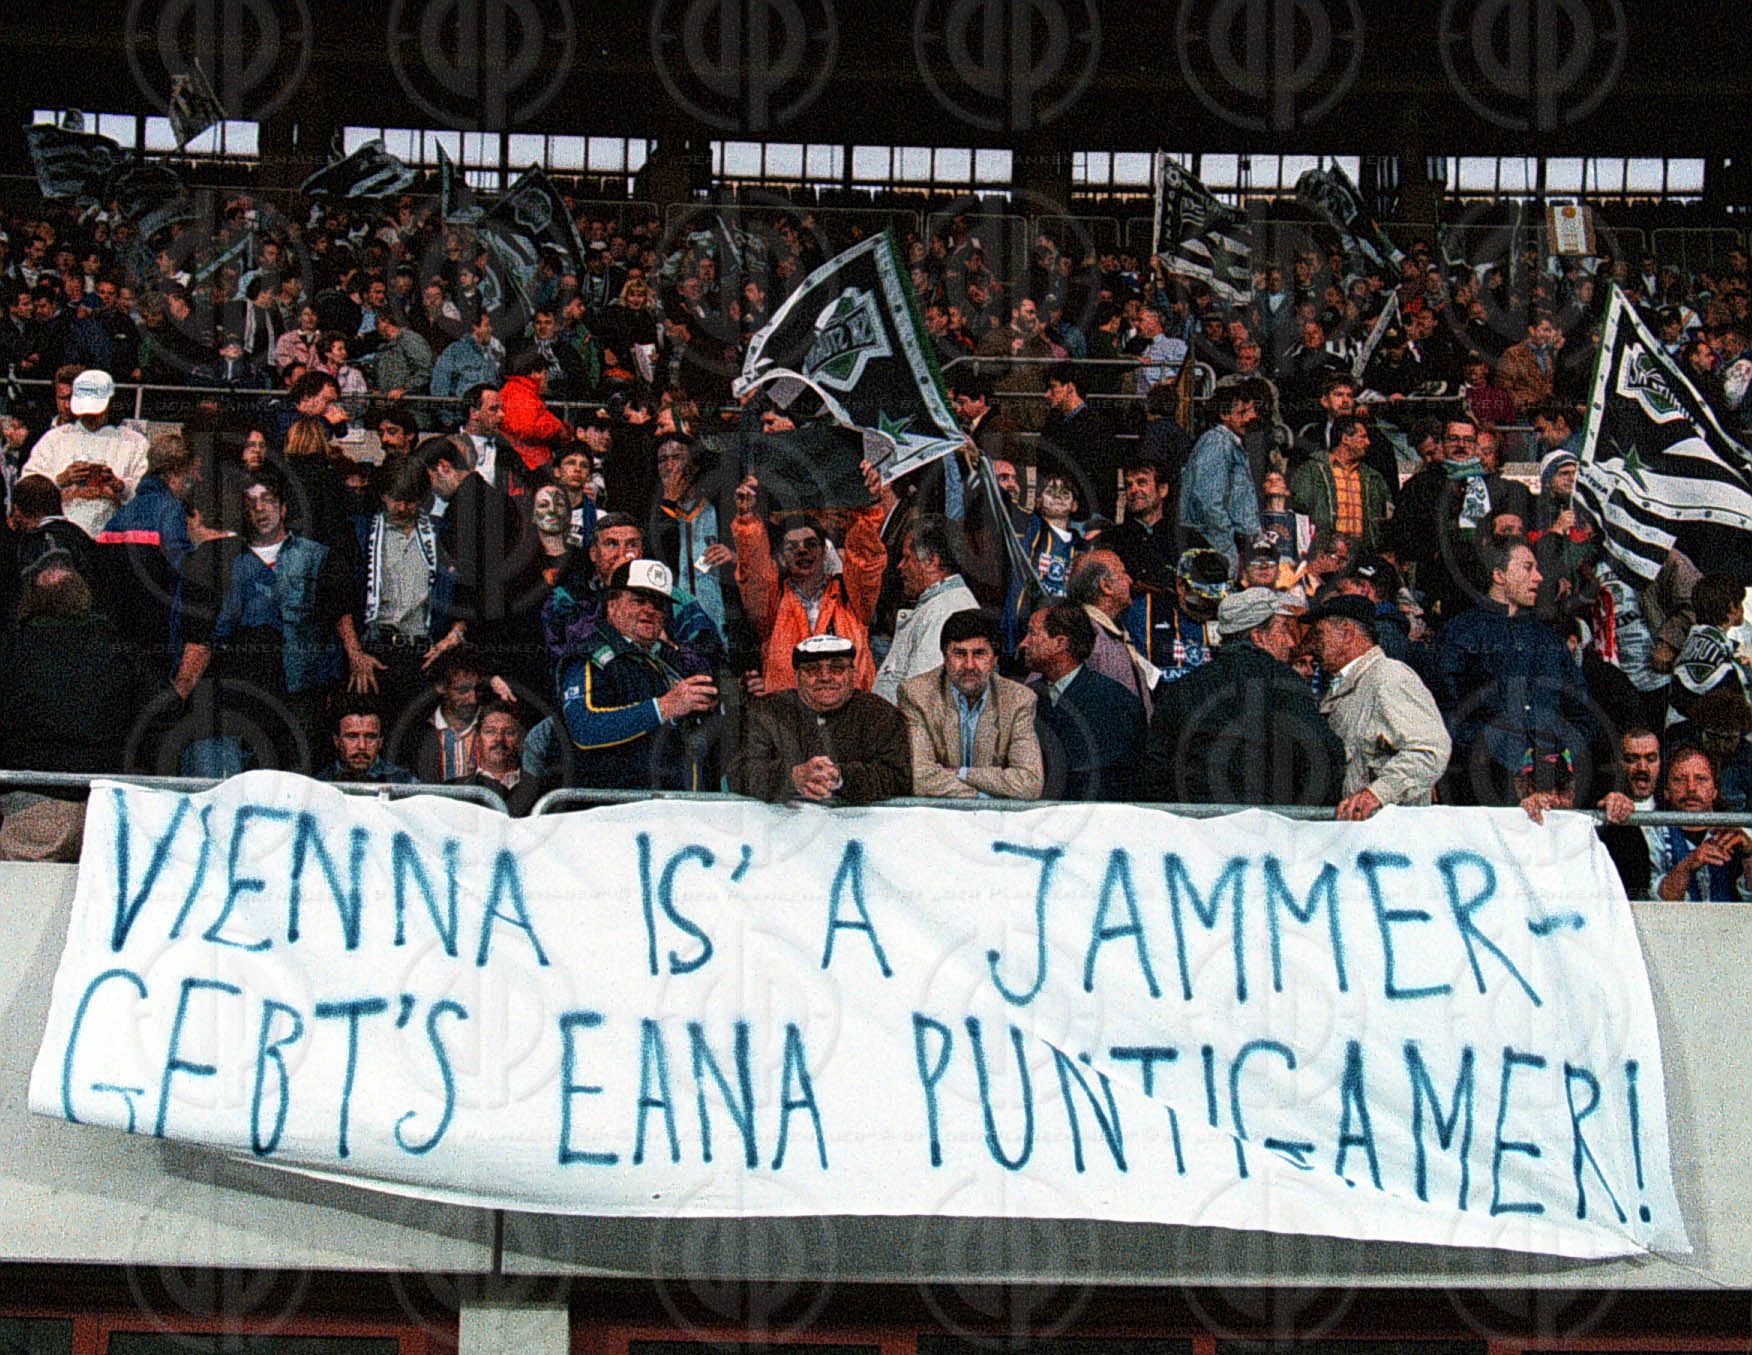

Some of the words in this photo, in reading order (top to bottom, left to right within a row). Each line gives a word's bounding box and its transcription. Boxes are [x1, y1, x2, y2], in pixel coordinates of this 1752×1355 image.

[112, 788, 550, 969] VIENNA
[822, 841, 893, 979] A
[61, 970, 469, 1161] GEBT'S
[558, 1012, 829, 1172] EANA
[912, 1012, 1653, 1225] PUNTIGAMER!
